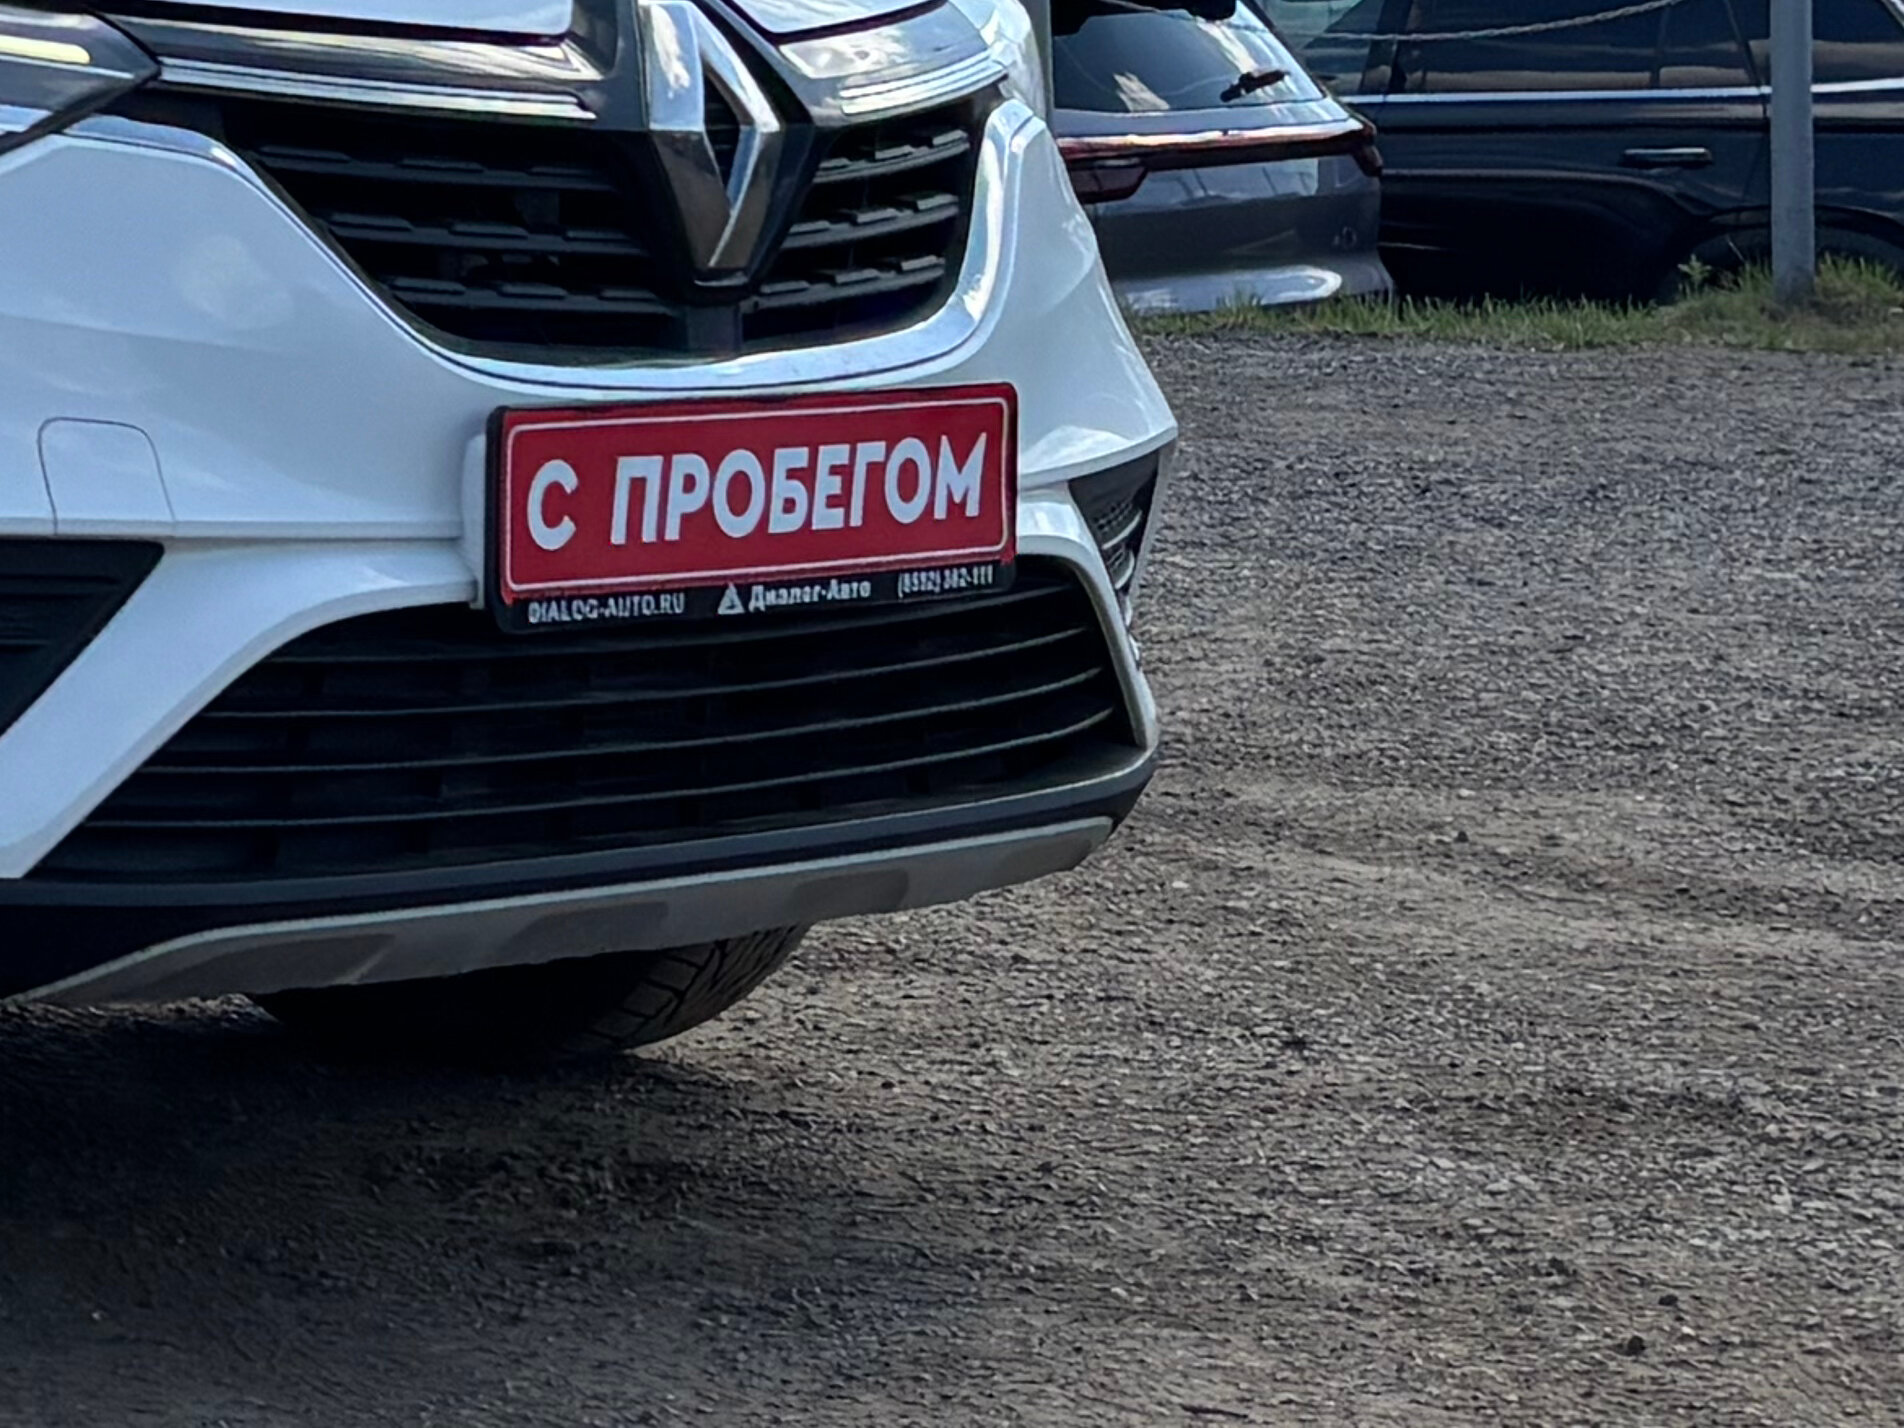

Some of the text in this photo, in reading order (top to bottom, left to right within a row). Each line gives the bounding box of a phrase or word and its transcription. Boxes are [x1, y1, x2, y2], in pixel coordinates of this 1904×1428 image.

[526, 431, 988, 551] С ПРОБЕГОМ
[527, 592, 686, 625] DIALOG-AUTO.RU
[747, 578, 872, 613] Диалог-Авто
